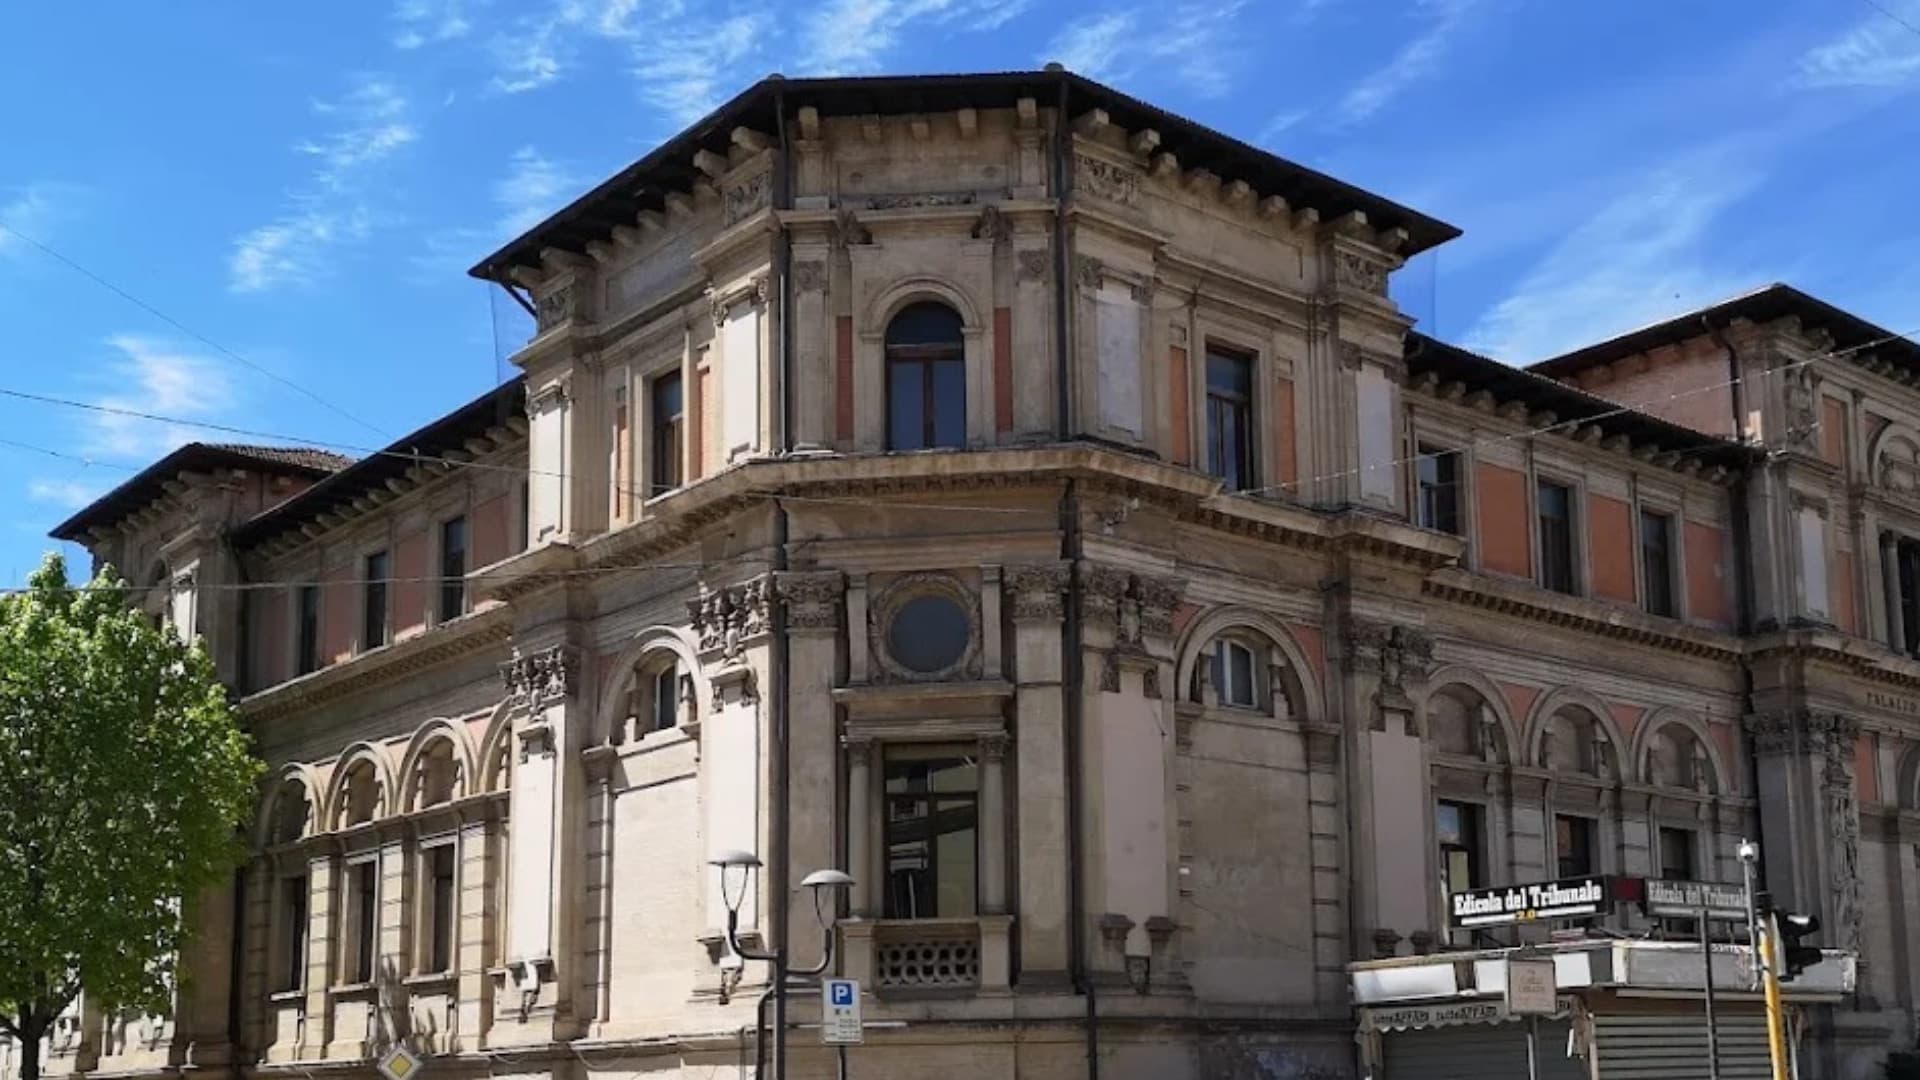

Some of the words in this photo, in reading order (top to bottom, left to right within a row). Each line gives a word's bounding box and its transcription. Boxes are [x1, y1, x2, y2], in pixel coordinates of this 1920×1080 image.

[1454, 891, 1502, 916] Edicola
[1505, 887, 1527, 911] del
[1528, 879, 1602, 908] Tribunale
[1648, 881, 1684, 903] Edicola
[1685, 883, 1701, 905] del
[835, 985, 848, 1003] P
